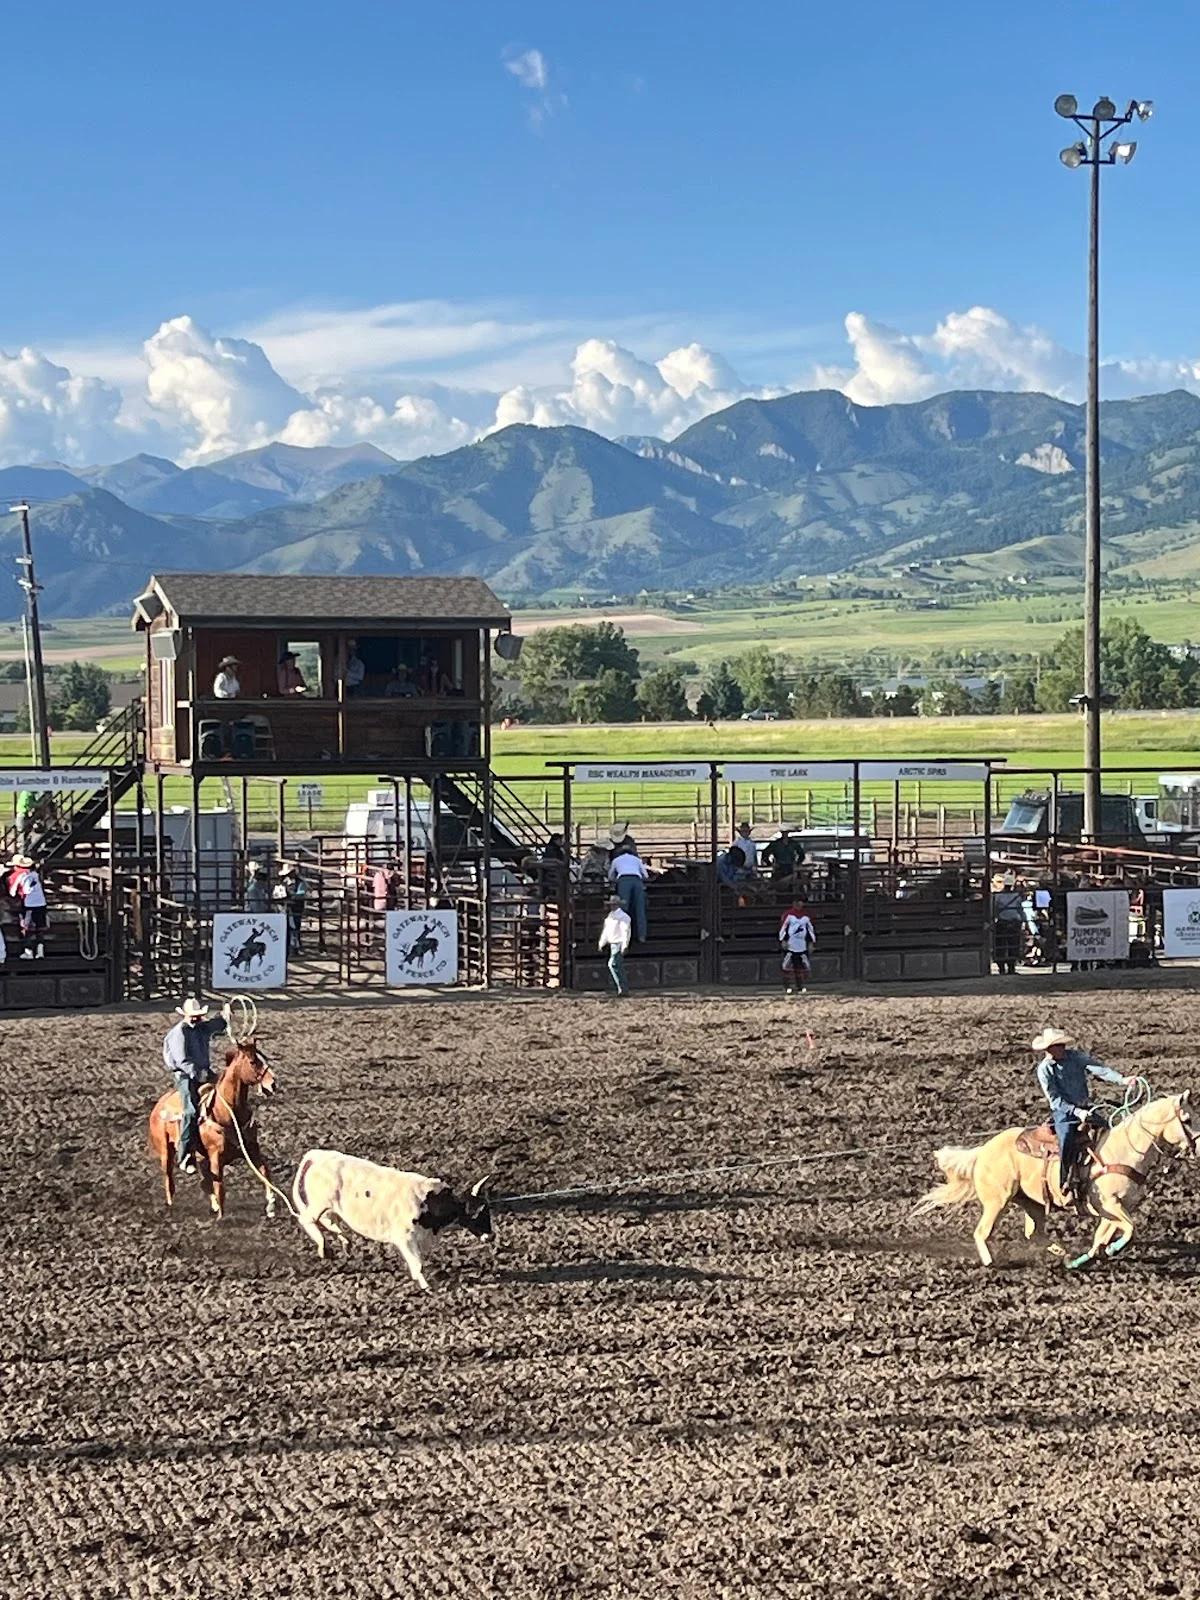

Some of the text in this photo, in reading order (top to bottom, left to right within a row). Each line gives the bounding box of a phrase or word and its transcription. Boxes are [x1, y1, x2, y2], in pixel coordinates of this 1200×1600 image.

[606, 769, 640, 778] WEALTH
[641, 768, 697, 778] MANAGEMENT
[770, 769, 808, 777] THE LARK
[898, 768, 926, 776] ARCTIC
[16, 776, 50, 785] Lumber
[61, 775, 103, 785] Hardware
[219, 918, 279, 943] GATEWAY ARCH
[392, 914, 451, 940] GATEWAY ARCH
[1070, 927, 1112, 939] JUMPING
[1075, 937, 1107, 946] HORSE
